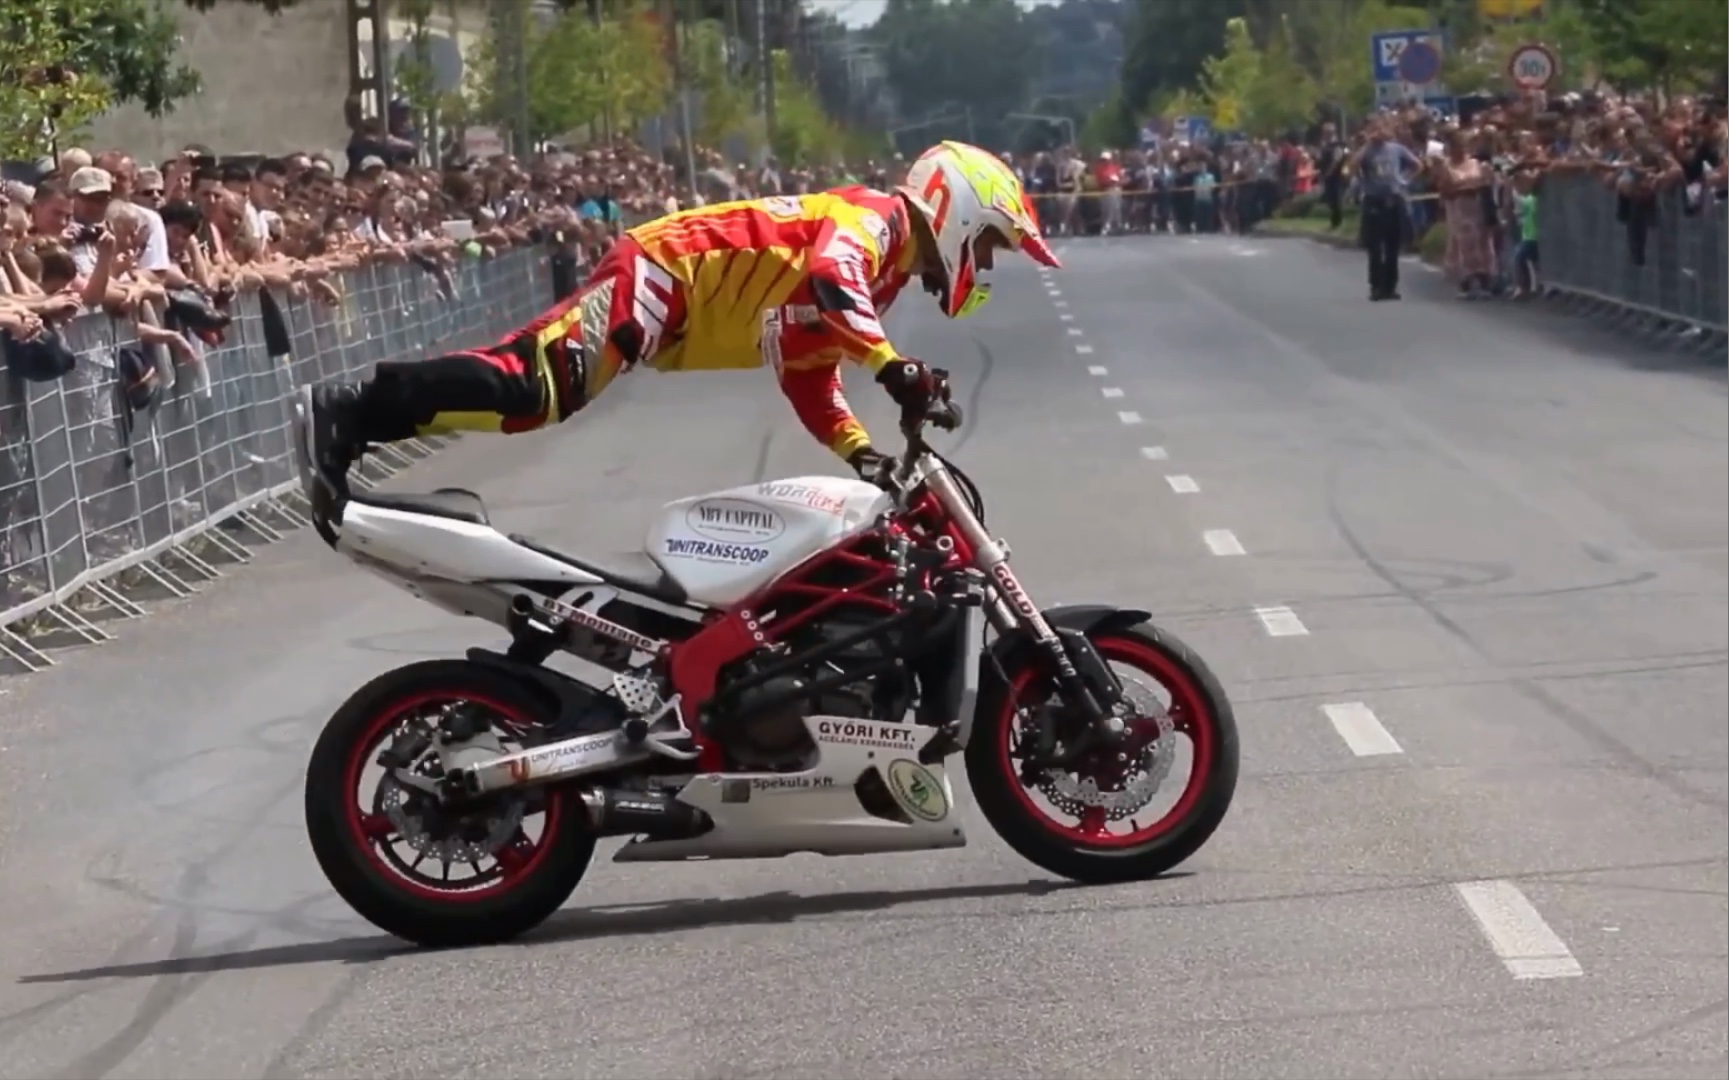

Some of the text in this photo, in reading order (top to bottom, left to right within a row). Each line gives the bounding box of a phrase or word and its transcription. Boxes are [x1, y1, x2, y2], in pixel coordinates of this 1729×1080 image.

[666, 538, 769, 562] UNITRANSCOOP
[994, 564, 1034, 616] GOLD
[880, 727, 916, 742] KFT.
[752, 776, 810, 790] Spekula
